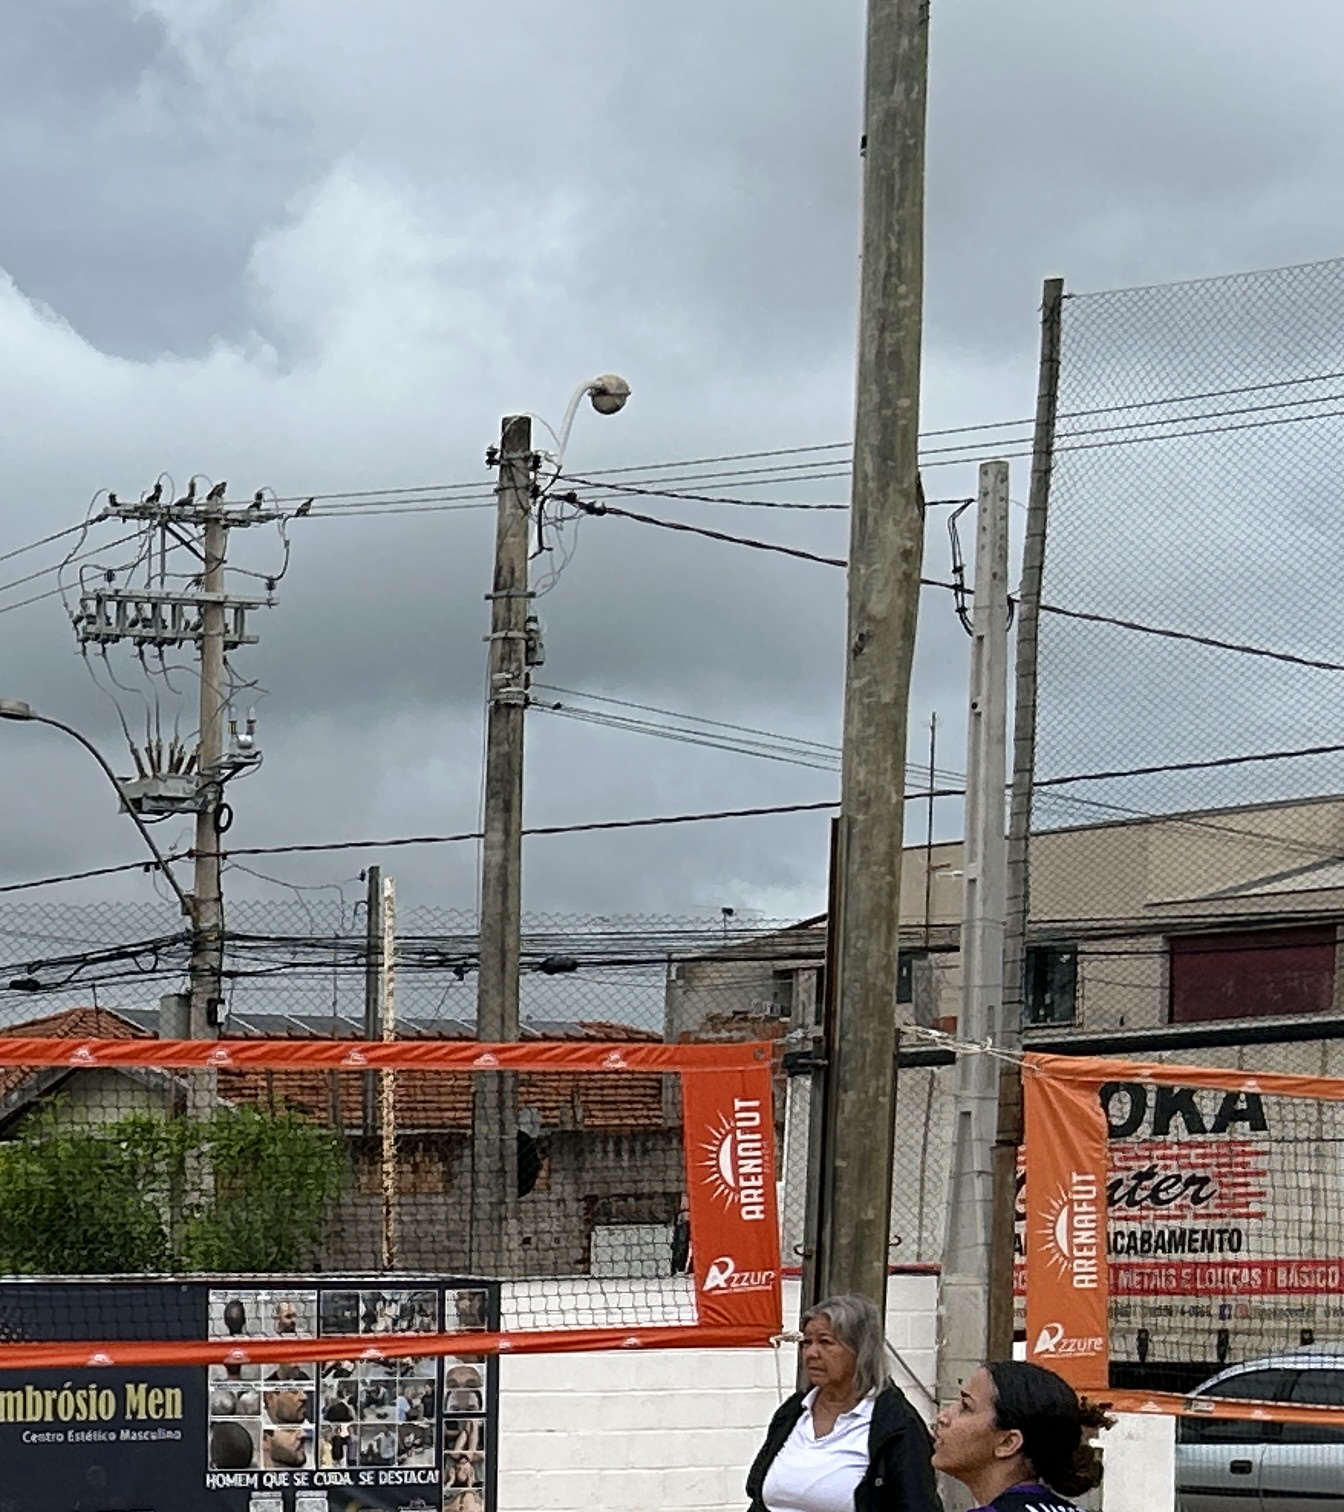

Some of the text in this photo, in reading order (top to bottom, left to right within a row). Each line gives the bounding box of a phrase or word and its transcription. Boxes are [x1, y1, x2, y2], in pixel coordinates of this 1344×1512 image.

[733, 1097, 766, 1221] ARENAFUT
[1072, 1171, 1099, 1290] ARENAFUT
[1107, 1229, 1243, 1255] CABAMENTO
[123, 1382, 184, 1421] Men
[22, 1427, 183, 1444] Centro Estético Masculino
[205, 1472, 259, 1490] HOMEM
[262, 1472, 290, 1488] QUE
[293, 1471, 310, 1487] SE
[358, 1470, 375, 1486] SE
